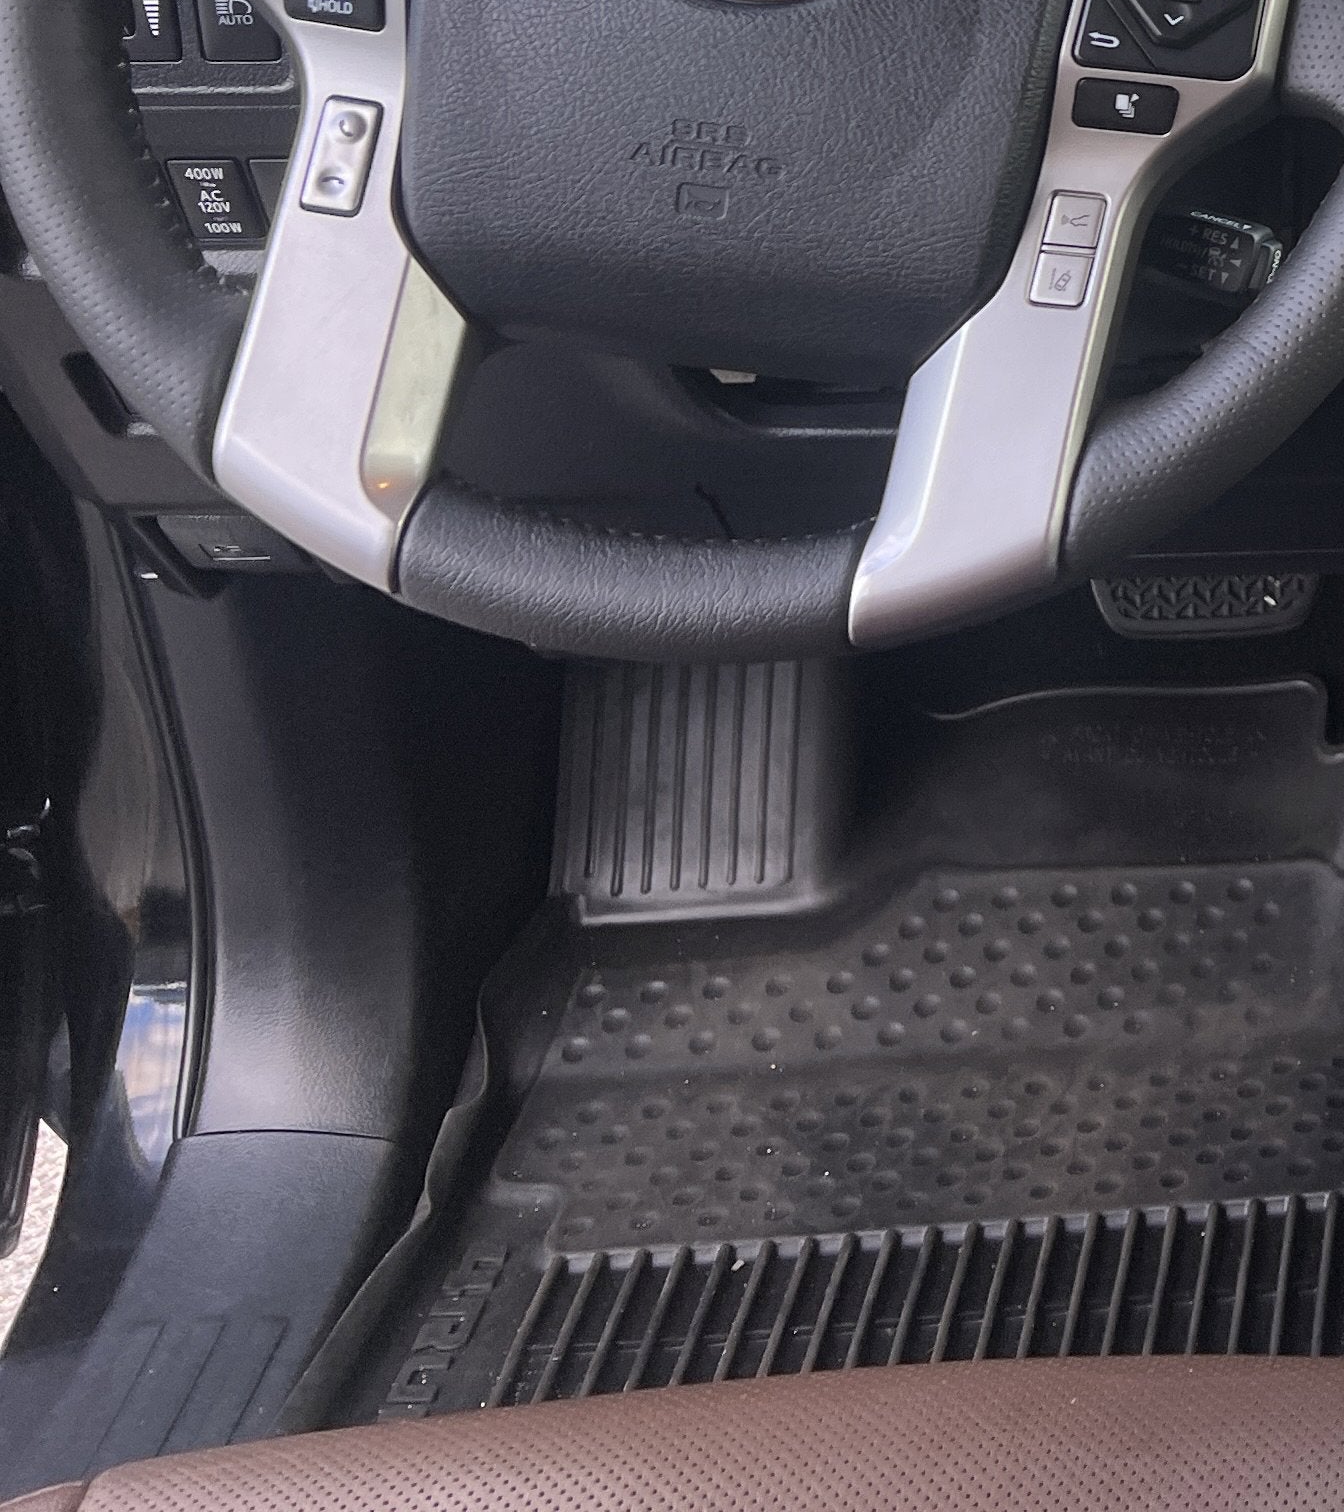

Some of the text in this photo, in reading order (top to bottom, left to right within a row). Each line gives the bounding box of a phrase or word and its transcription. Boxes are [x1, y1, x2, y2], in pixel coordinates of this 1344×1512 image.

[319, 0, 354, 15] HOLD
[218, 14, 254, 26] AUTO
[184, 167, 224, 180] 400W
[200, 190, 224, 202] AC
[197, 201, 231, 214] 120V
[204, 222, 242, 234] 100W
